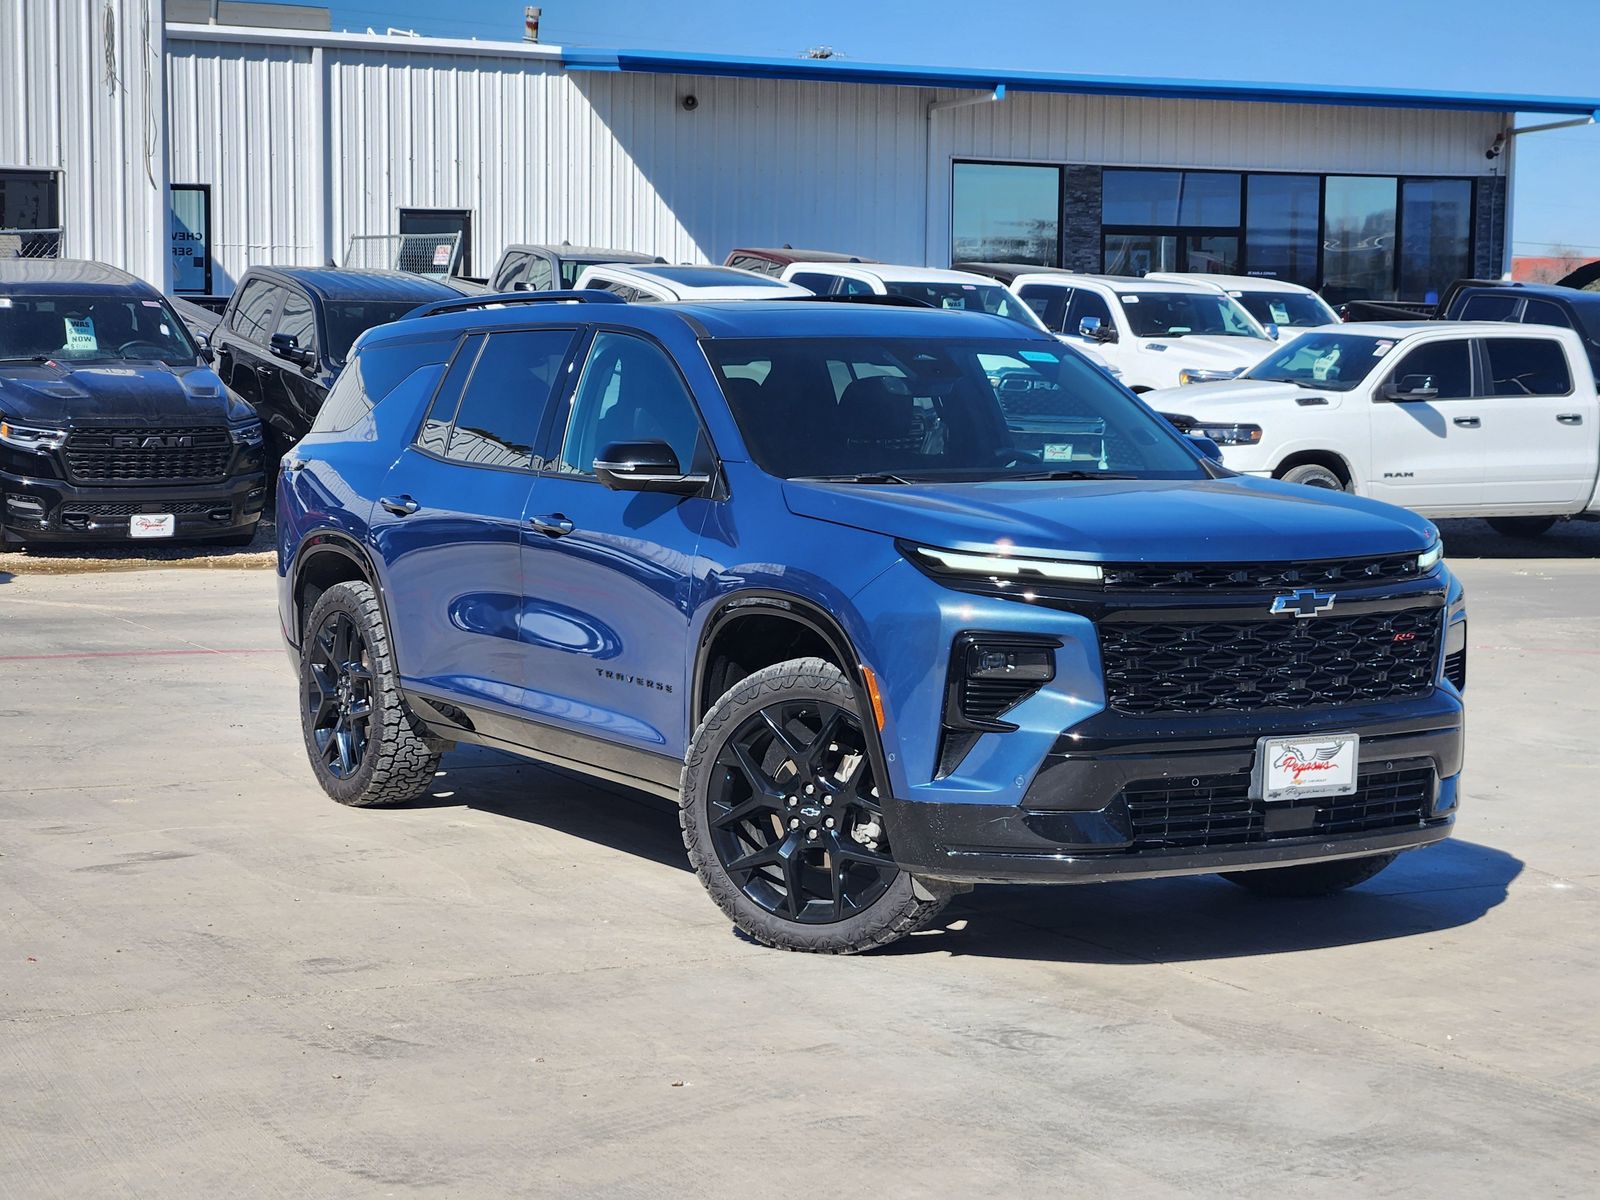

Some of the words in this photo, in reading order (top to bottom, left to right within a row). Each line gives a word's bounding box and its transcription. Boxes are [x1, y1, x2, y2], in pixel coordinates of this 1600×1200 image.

[112, 436, 192, 448] RAM
[1393, 632, 1416, 641] RS
[596, 667, 673, 693] TRAVERSE
[1283, 756, 1339, 779] Pegasus
